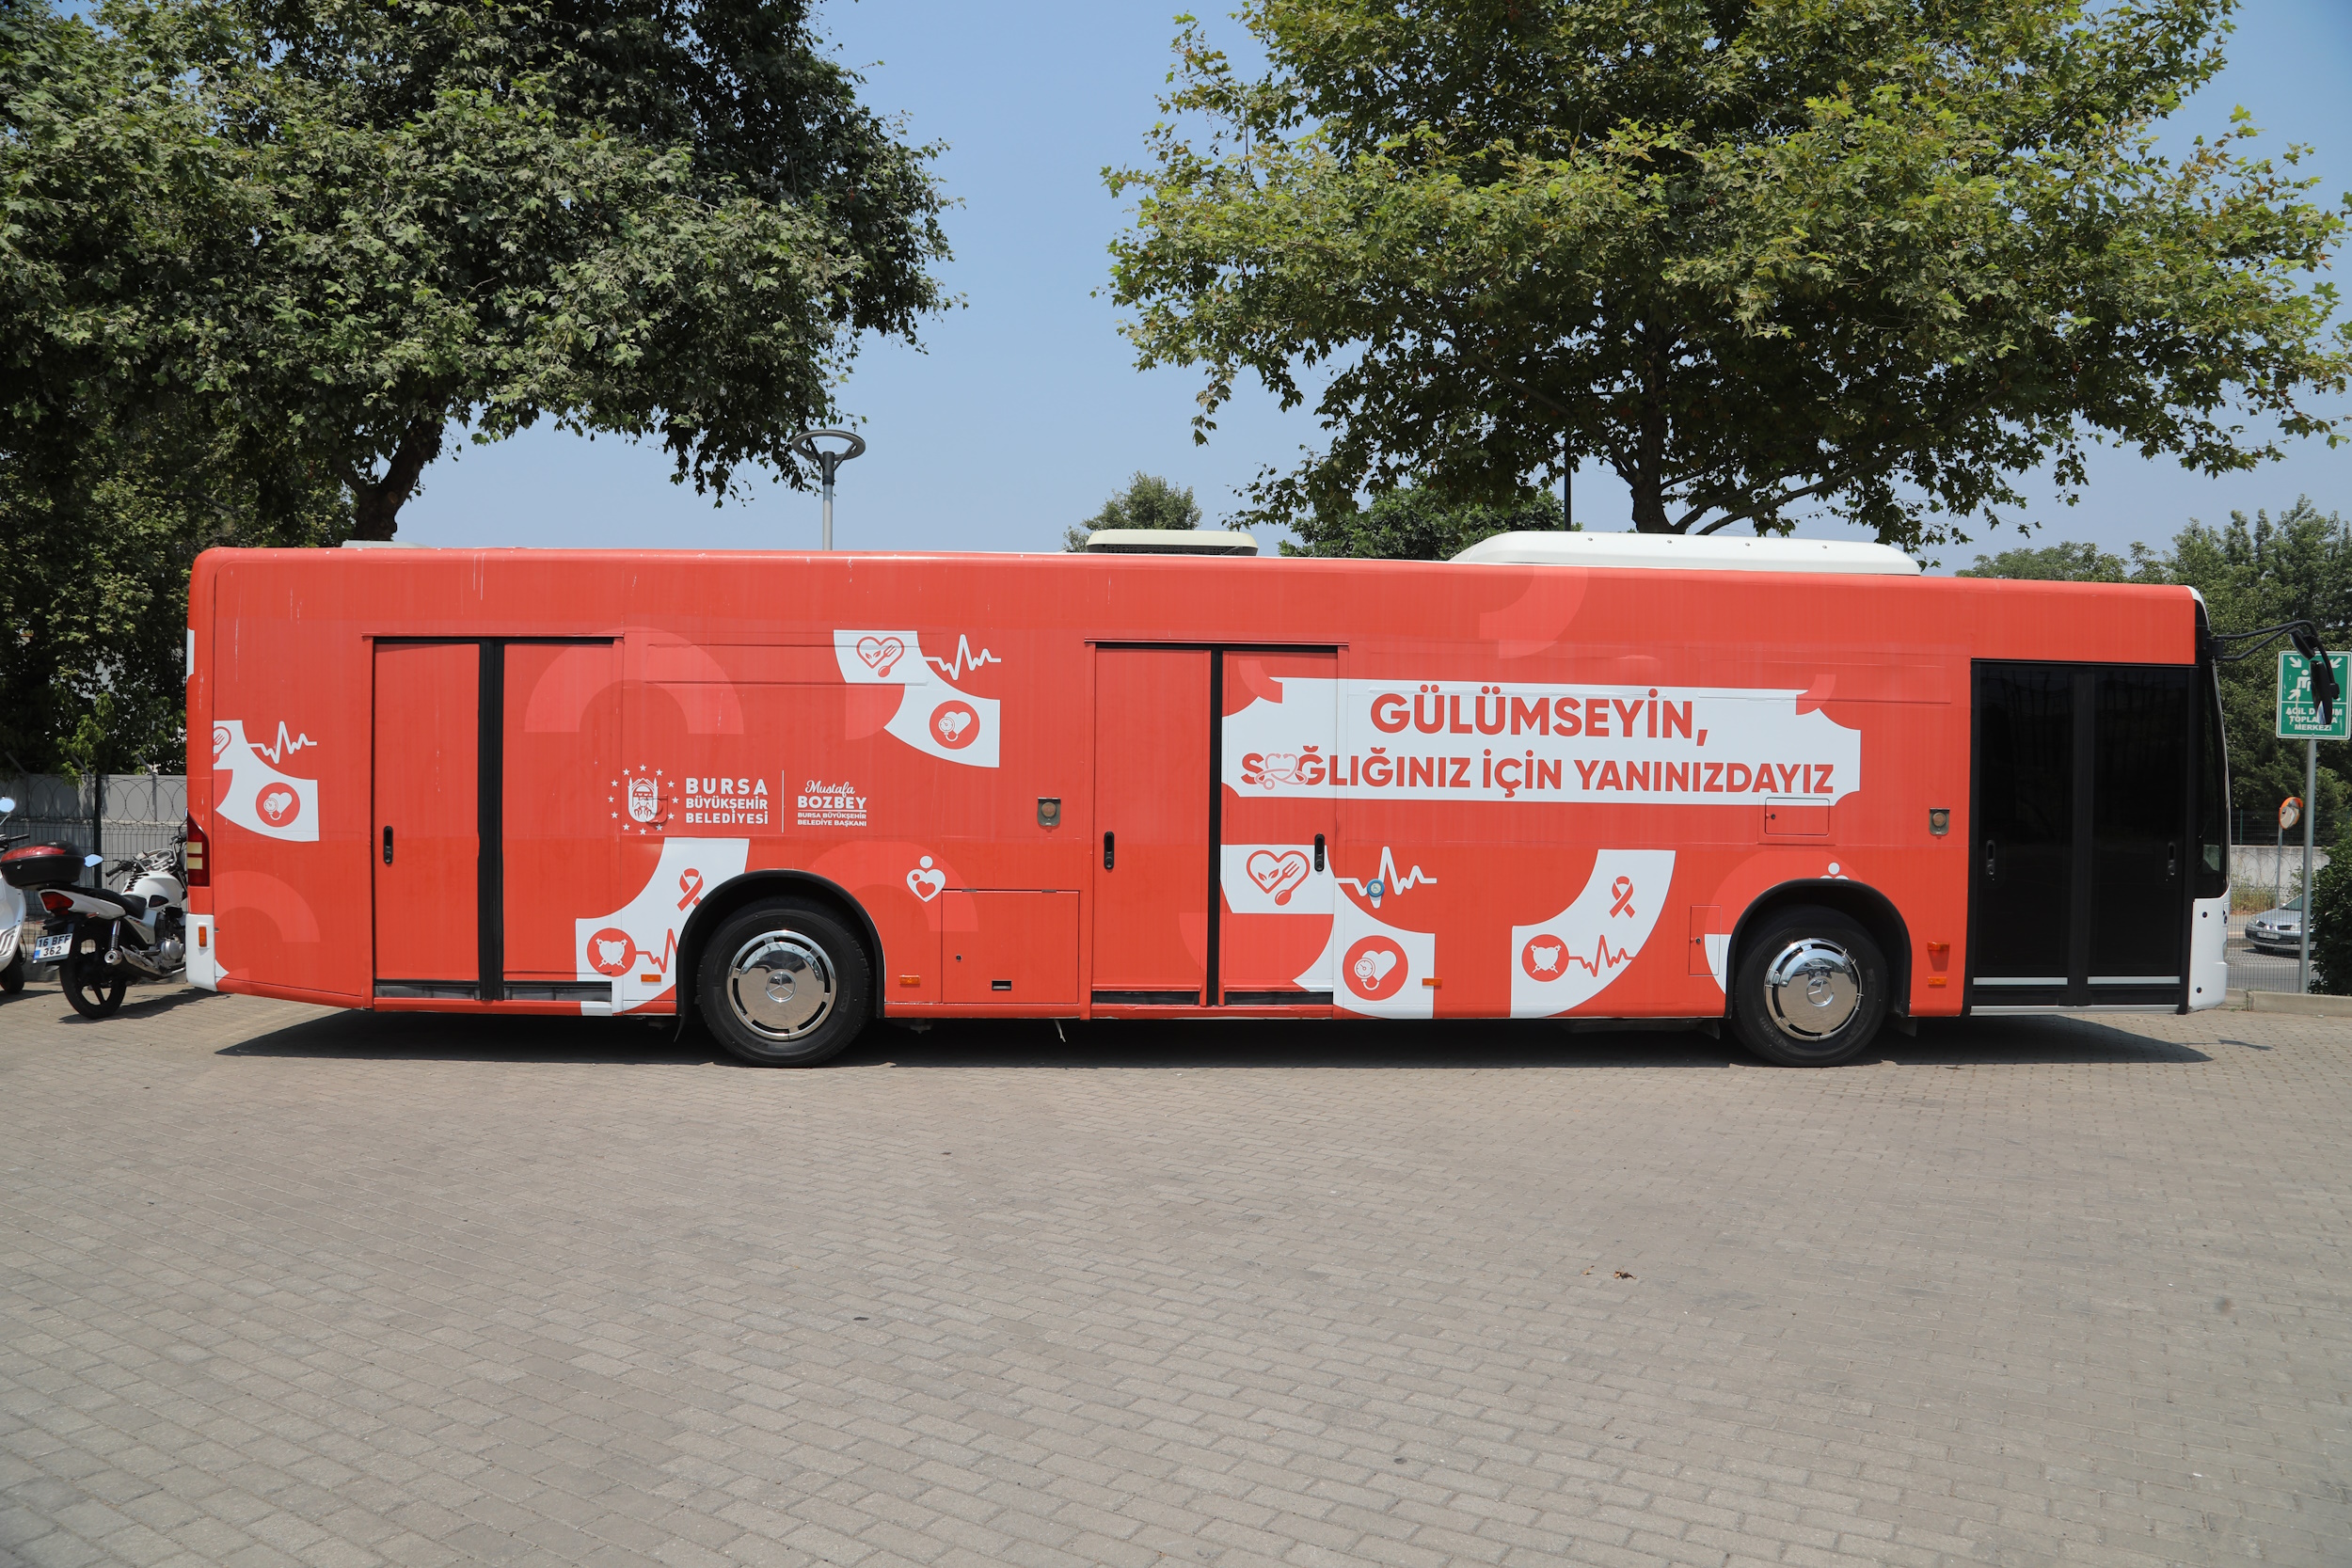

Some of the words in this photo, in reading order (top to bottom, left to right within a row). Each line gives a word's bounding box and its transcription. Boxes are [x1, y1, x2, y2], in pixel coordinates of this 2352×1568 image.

[1371, 684, 1708, 747] GÜLÜMSEYİN,
[1240, 745, 1470, 790] SĞLIĞINIZ
[1483, 749, 1563, 798] İÇİN
[1574, 759, 1834, 795] YANINIZDAYIZ
[685, 777, 768, 796] BURSA
[804, 779, 855, 798] Mustafa
[685, 795, 768, 811] BÜYÜKŞEHİR
[797, 795, 867, 810] BOZBEY
[685, 810, 768, 825] BELEDİYESİ
[822, 811, 866, 820] BÜYÜKŞEHİR
[39, 938, 49, 948] 16
[43, 945, 62, 956] 362
